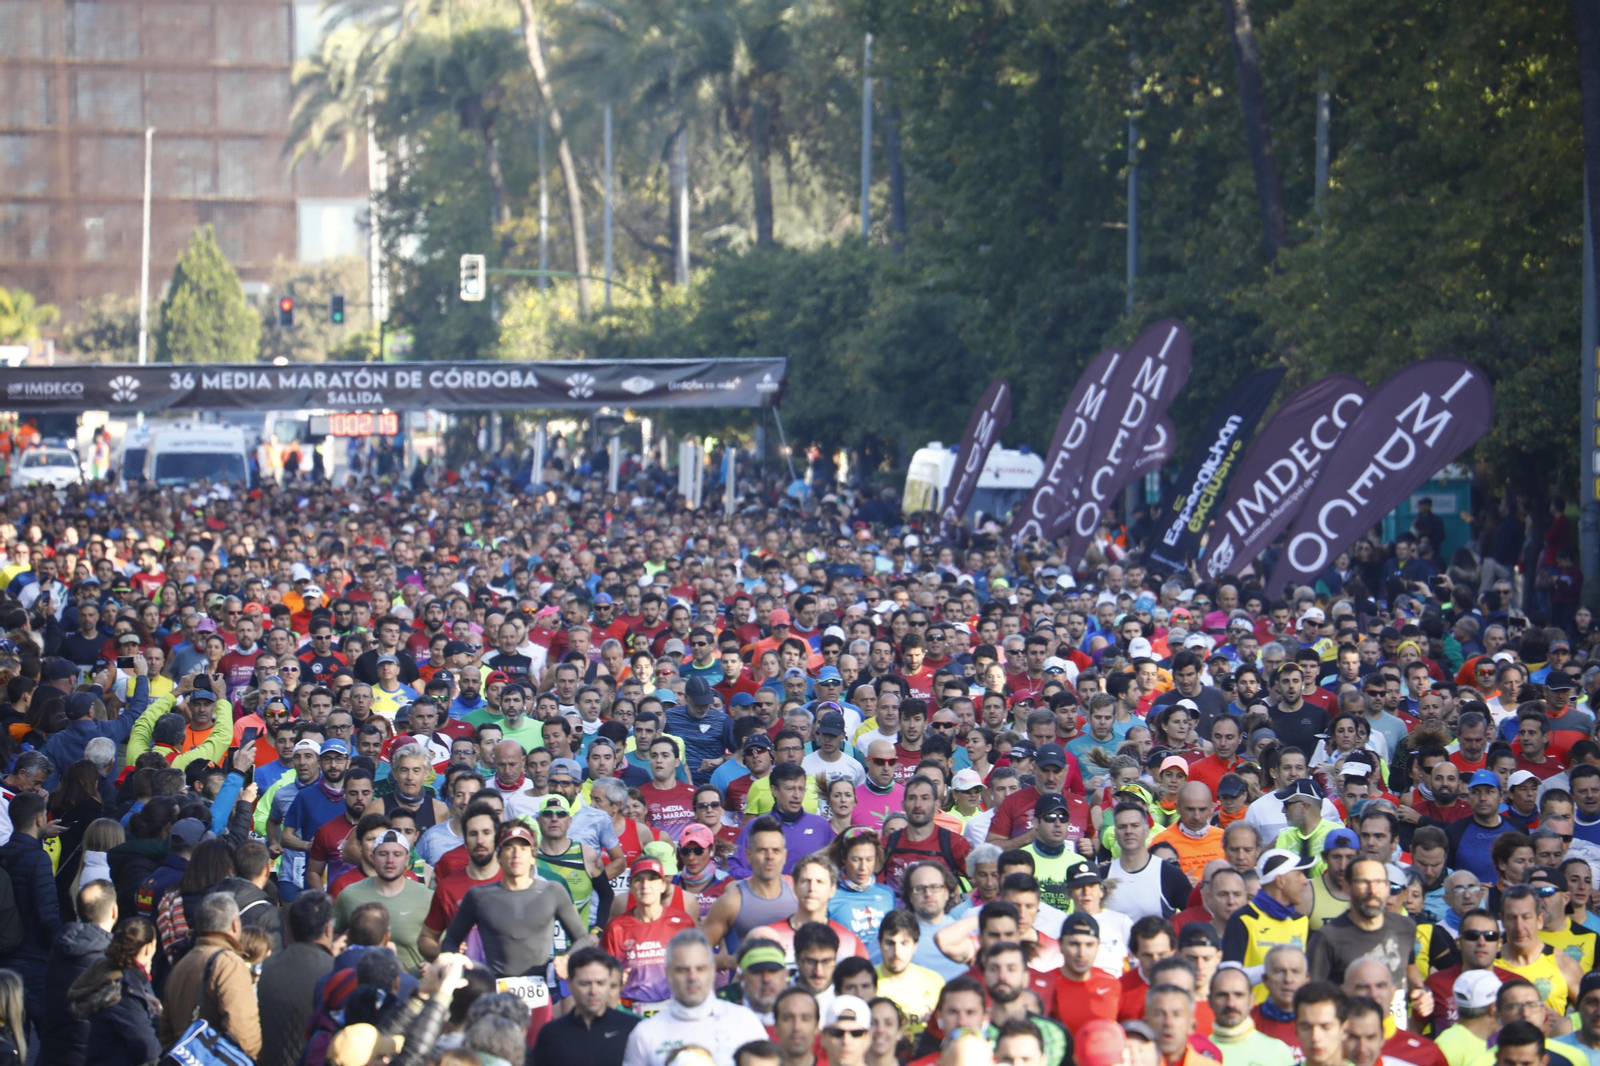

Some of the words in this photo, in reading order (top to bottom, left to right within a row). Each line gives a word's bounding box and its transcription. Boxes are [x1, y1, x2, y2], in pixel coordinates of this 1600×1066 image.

[169, 372, 196, 390] 36
[201, 372, 272, 390] MEDIA
[278, 367, 388, 389] MARATÓN
[395, 371, 423, 388] DE
[429, 367, 539, 388] CÓRDOBA
[25, 381, 85, 396] IMDECO
[327, 391, 384, 405] SALIDA
[1075, 325, 1178, 538] IMDECO
[1288, 370, 1473, 573] IMDECO
[1188, 439, 1243, 533] exclusive
[661, 805, 684, 813] MEDIA
[651, 813, 662, 821] 36
[636, 941, 662, 950] MEDIA
